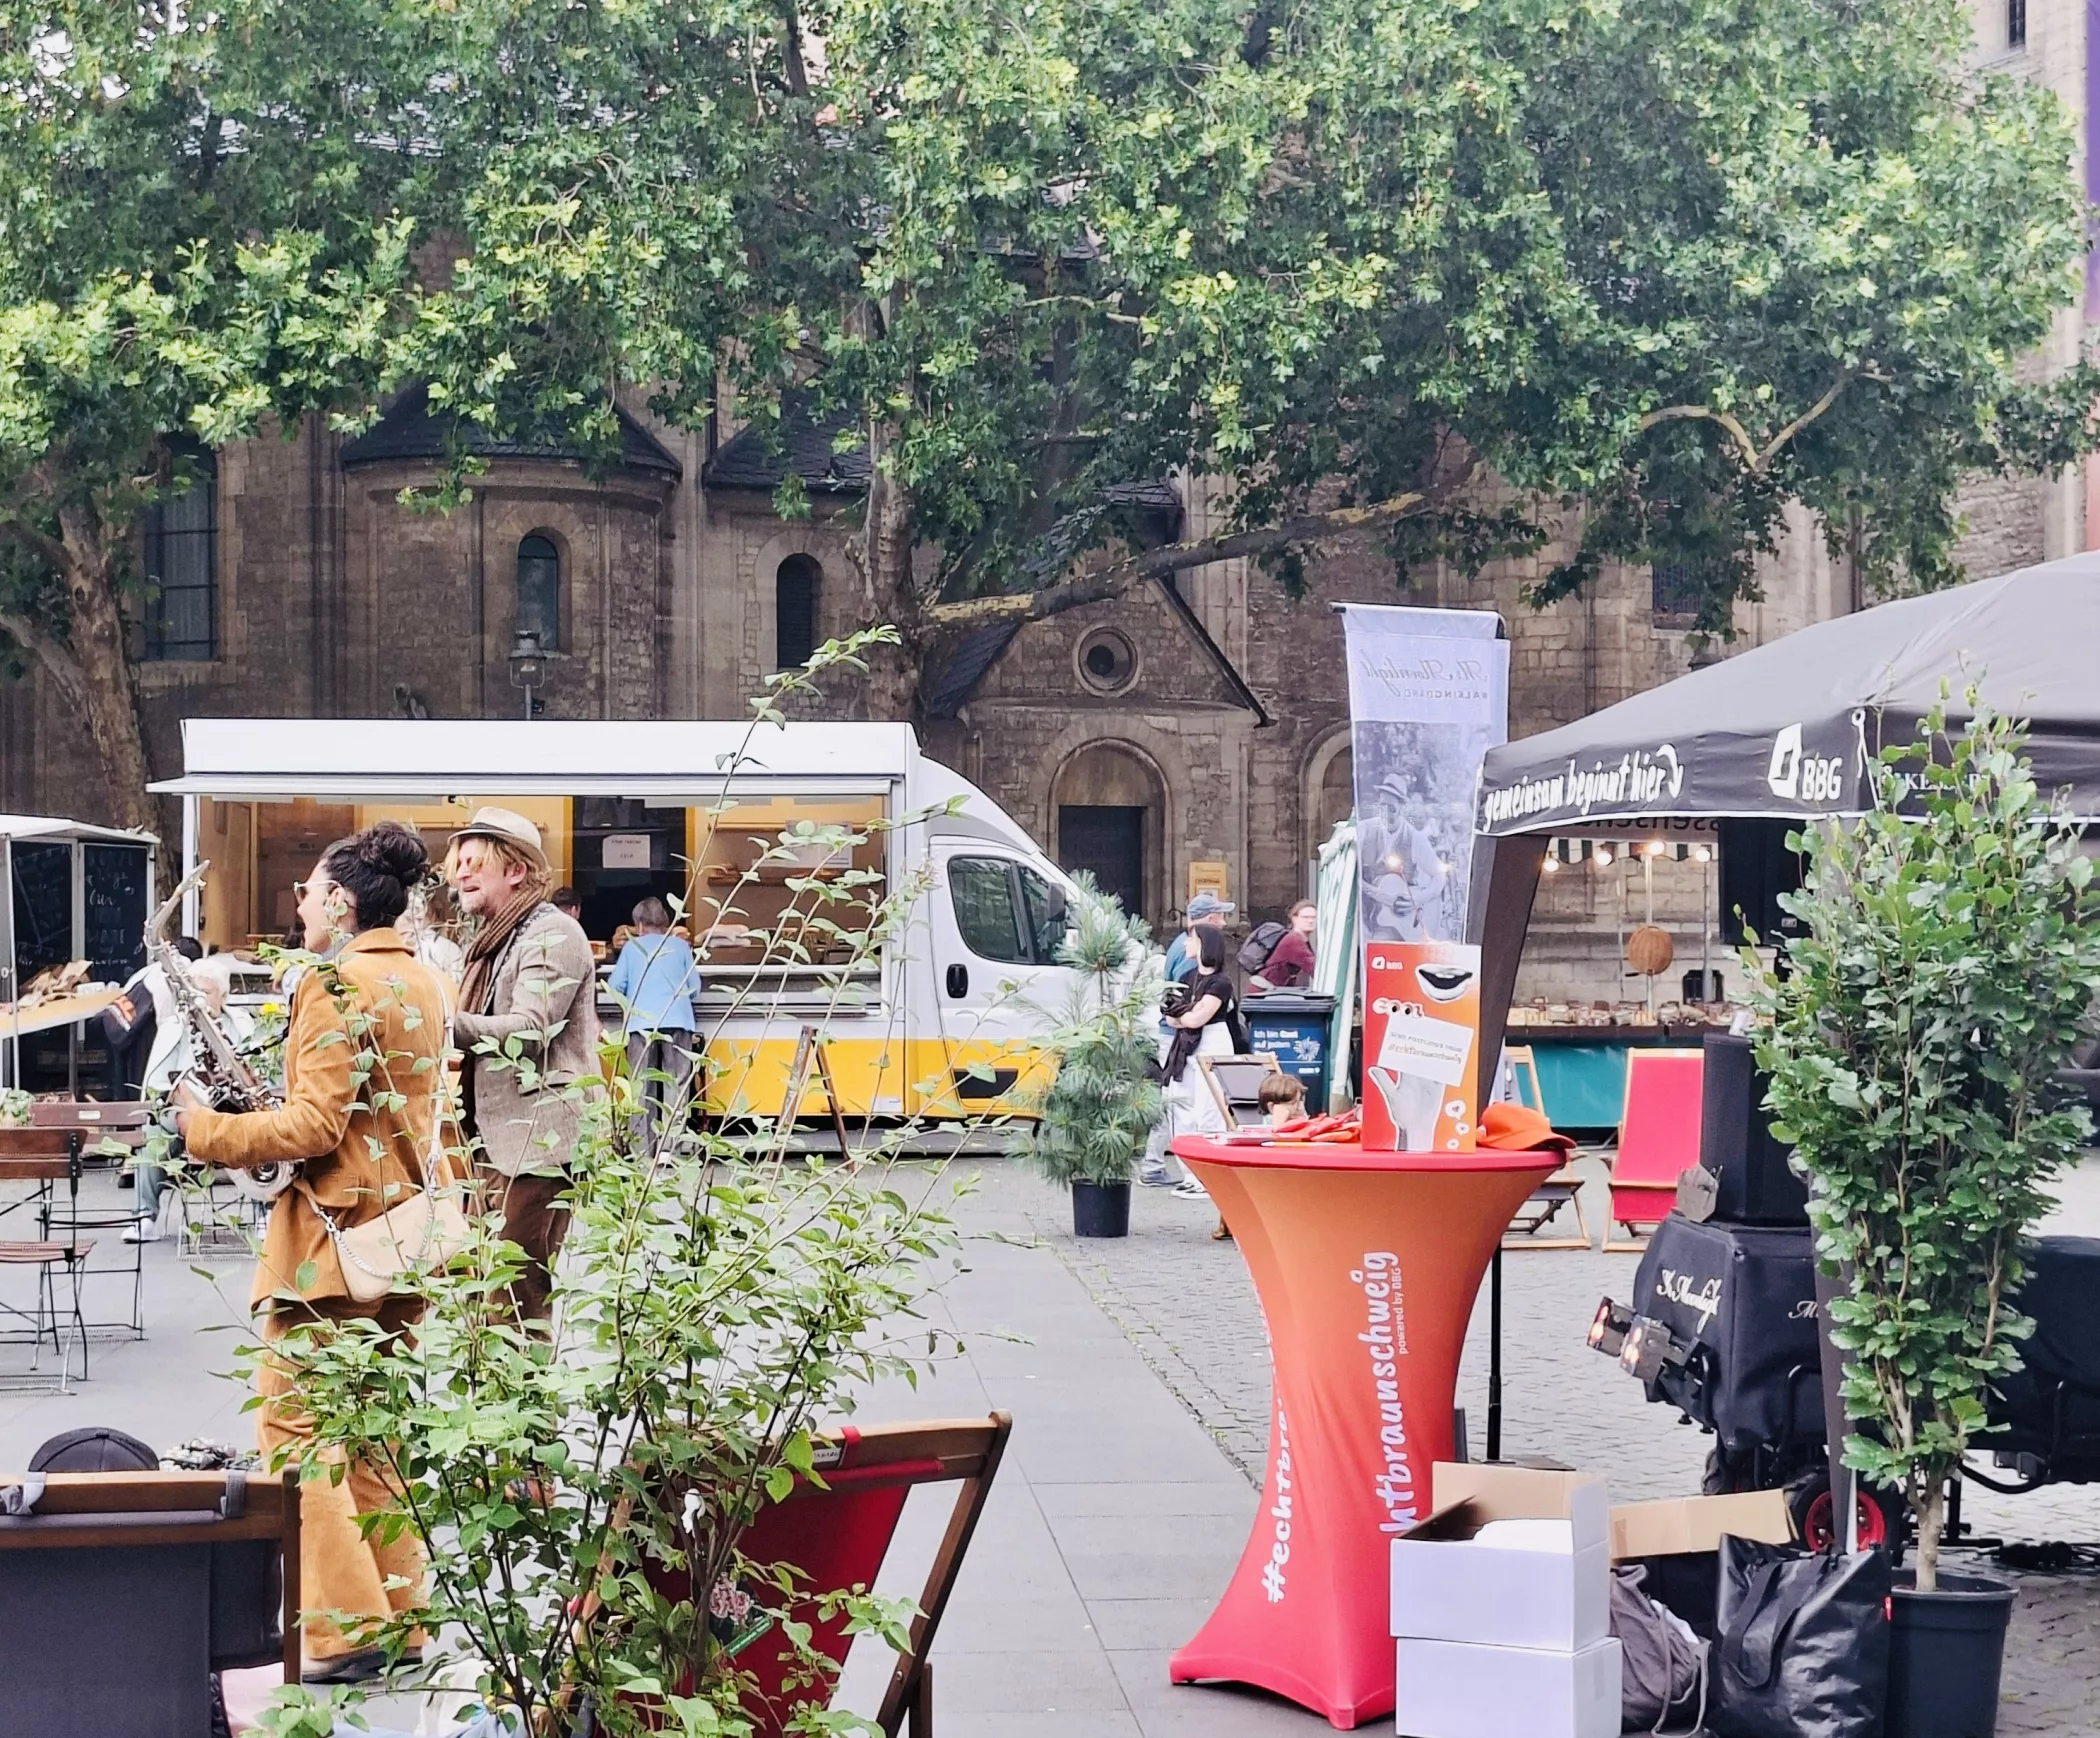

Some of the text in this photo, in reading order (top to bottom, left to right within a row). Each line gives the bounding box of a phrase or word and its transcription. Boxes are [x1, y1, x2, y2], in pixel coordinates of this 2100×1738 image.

[1484, 749, 1666, 833] gemeinsam beginnt hier
[1801, 756, 1843, 801] BBG
